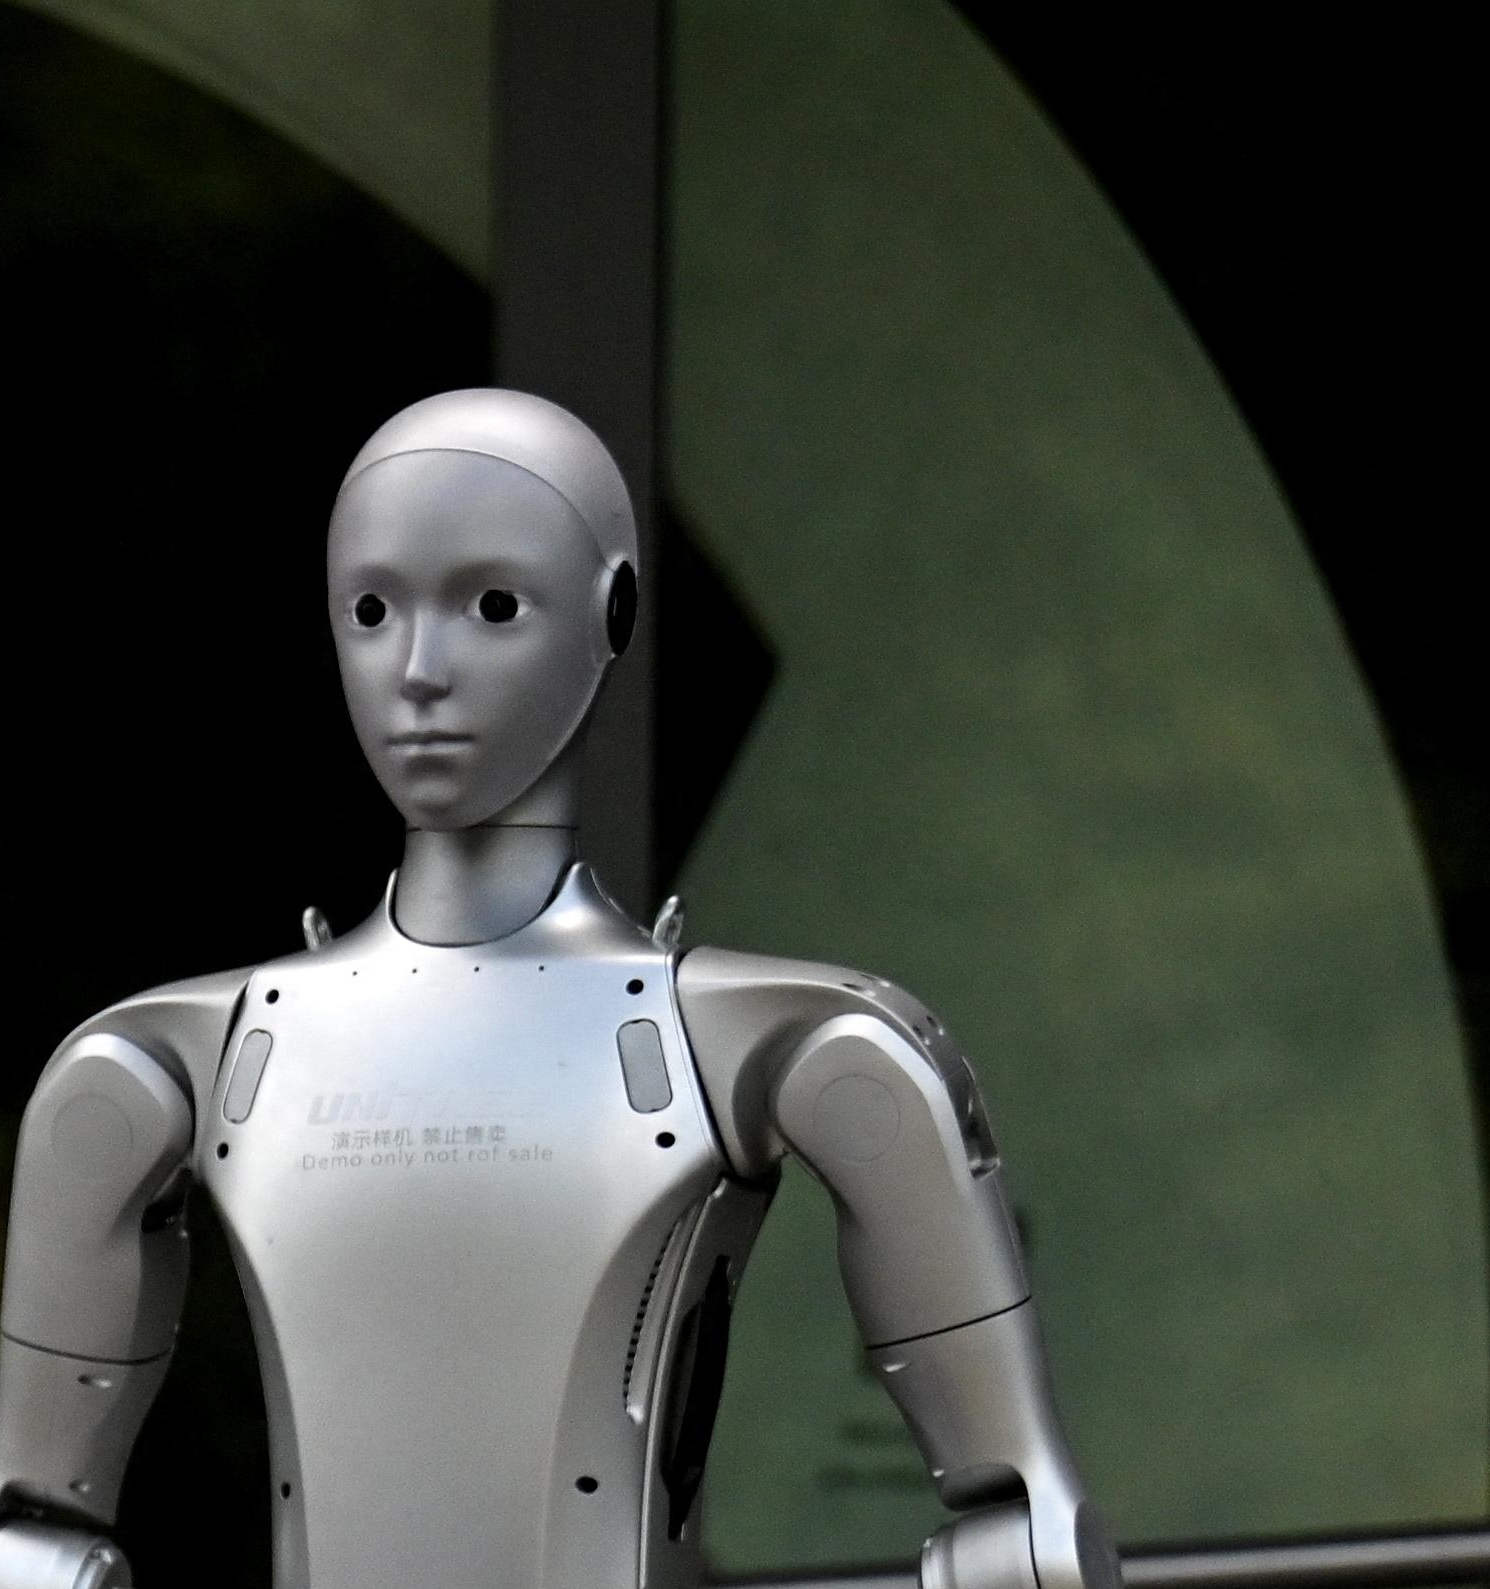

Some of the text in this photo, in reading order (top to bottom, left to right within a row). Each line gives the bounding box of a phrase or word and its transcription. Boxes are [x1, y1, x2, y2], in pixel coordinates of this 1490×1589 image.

[331, 1128, 413, 1150] 演示样机
[302, 1153, 362, 1172] Demo
[370, 1149, 415, 1168] only
[423, 1147, 459, 1163] not
[507, 1144, 554, 1162] sale
